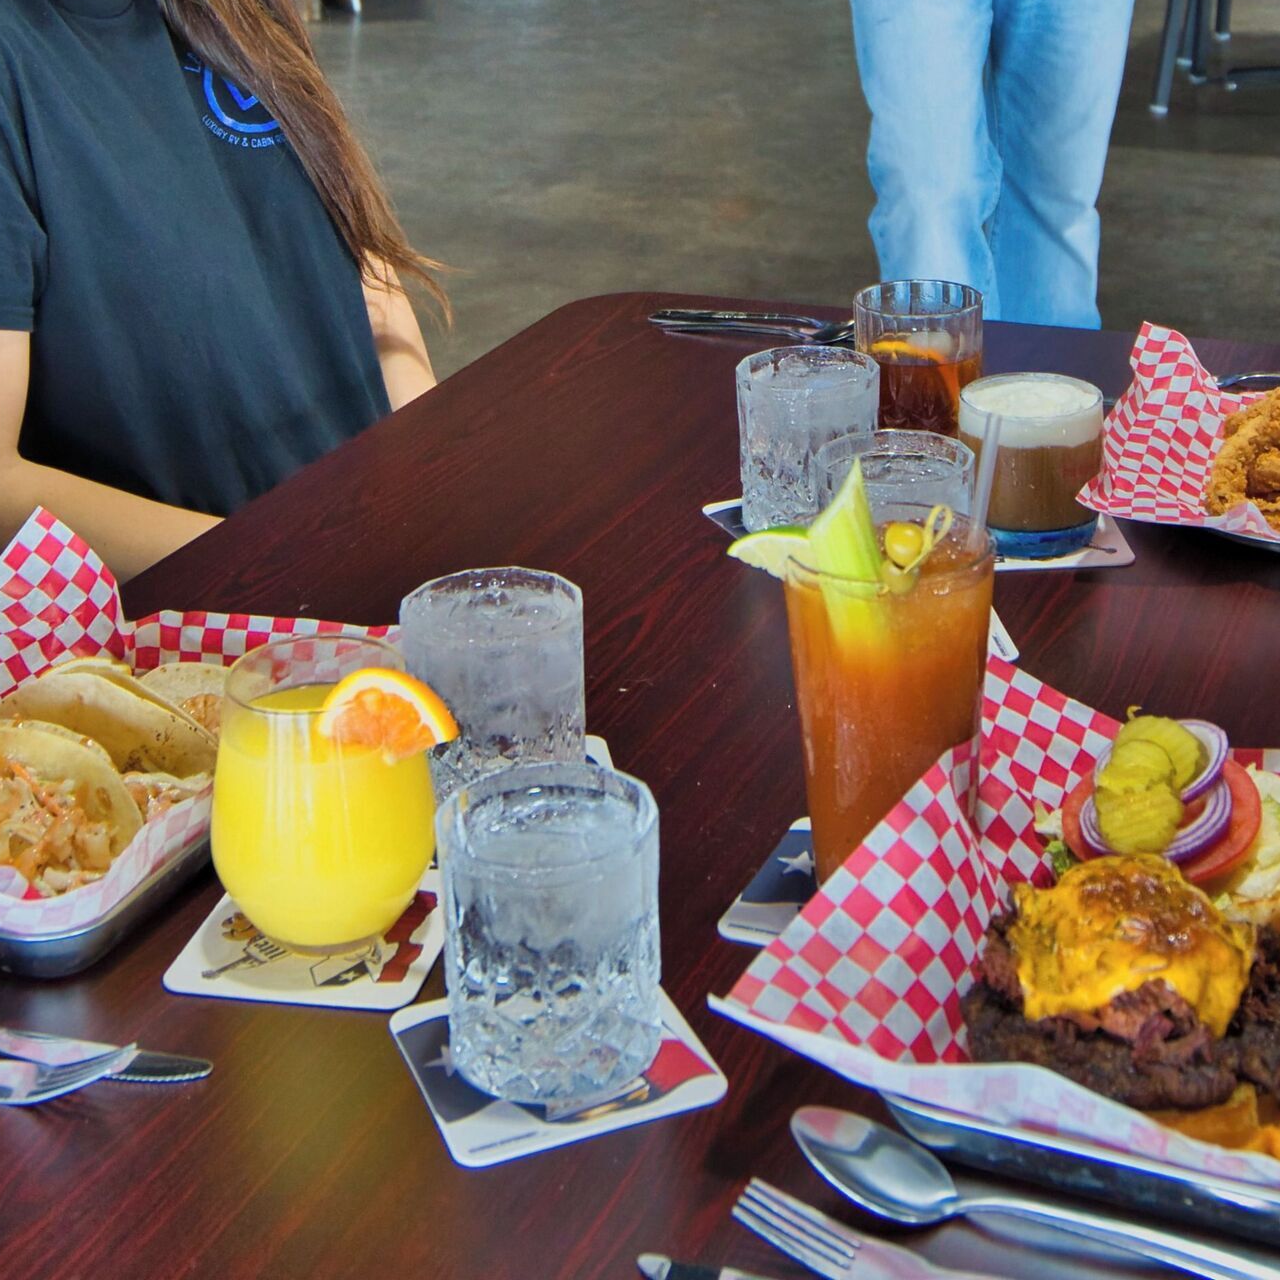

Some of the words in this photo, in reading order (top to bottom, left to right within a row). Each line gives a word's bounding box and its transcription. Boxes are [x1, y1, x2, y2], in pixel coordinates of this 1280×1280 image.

[202, 114, 228, 140] LUXURY
[228, 134, 240, 145] RV
[241, 137, 249, 147] &
[251, 136, 275, 148] CABIN
